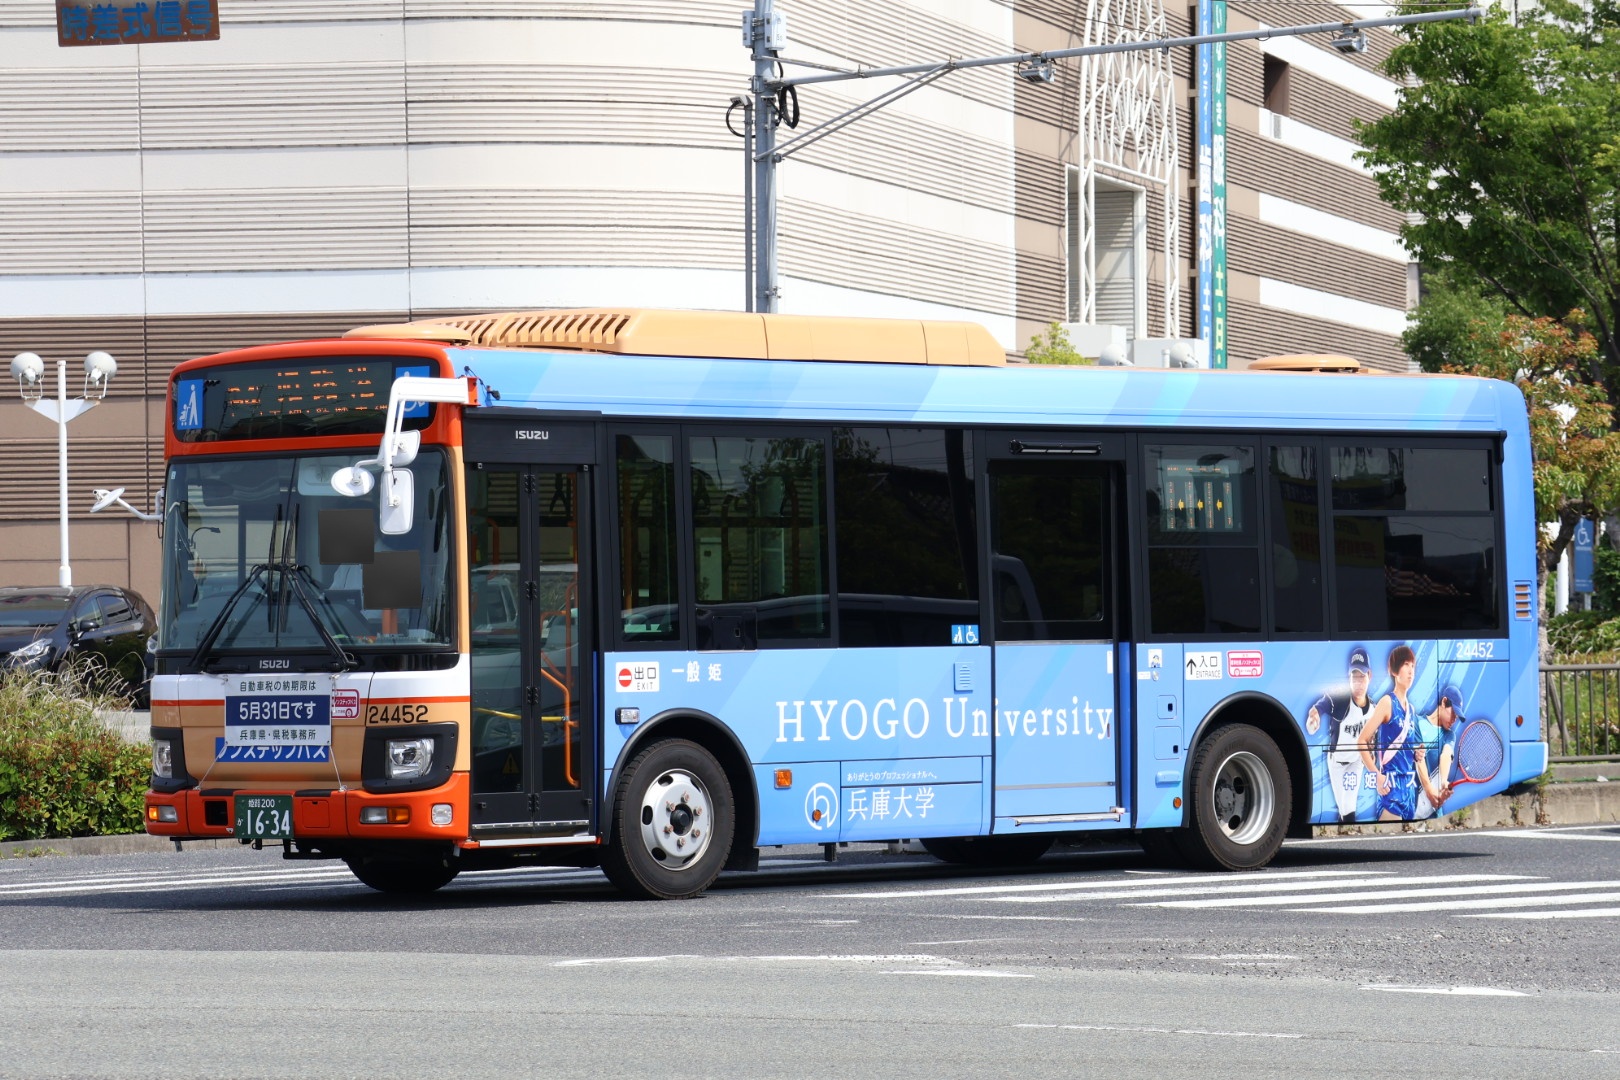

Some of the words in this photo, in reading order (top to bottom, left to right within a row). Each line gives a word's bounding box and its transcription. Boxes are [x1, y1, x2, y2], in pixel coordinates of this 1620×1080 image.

[61, 0, 214, 40] 時差式信号
[515, 430, 549, 440] ISUZU
[1456, 642, 1494, 658] 24452
[259, 659, 290, 669] ISUZU
[1199, 655, 1218, 668] 入口
[634, 666, 657, 680] 出口
[671, 661, 700, 682] 一般
[1195, 669, 1221, 679] ENTRANCE
[240, 680, 317, 692] 自動車税の納期限は
[636, 682, 654, 691] EXIT
[239, 701, 317, 720] 5月31日です
[369, 704, 429, 724] 24452
[775, 697, 930, 743] HYOGO
[943, 695, 1113, 740] University
[239, 729, 317, 741] 兵庫県・県税事務所
[847, 770, 938, 782] ありがとうのプロフェッショナルへ。
[1343, 772, 1418, 791] 神姫バス
[261, 799, 276, 808] 200
[847, 786, 935, 822] 兵庫大学
